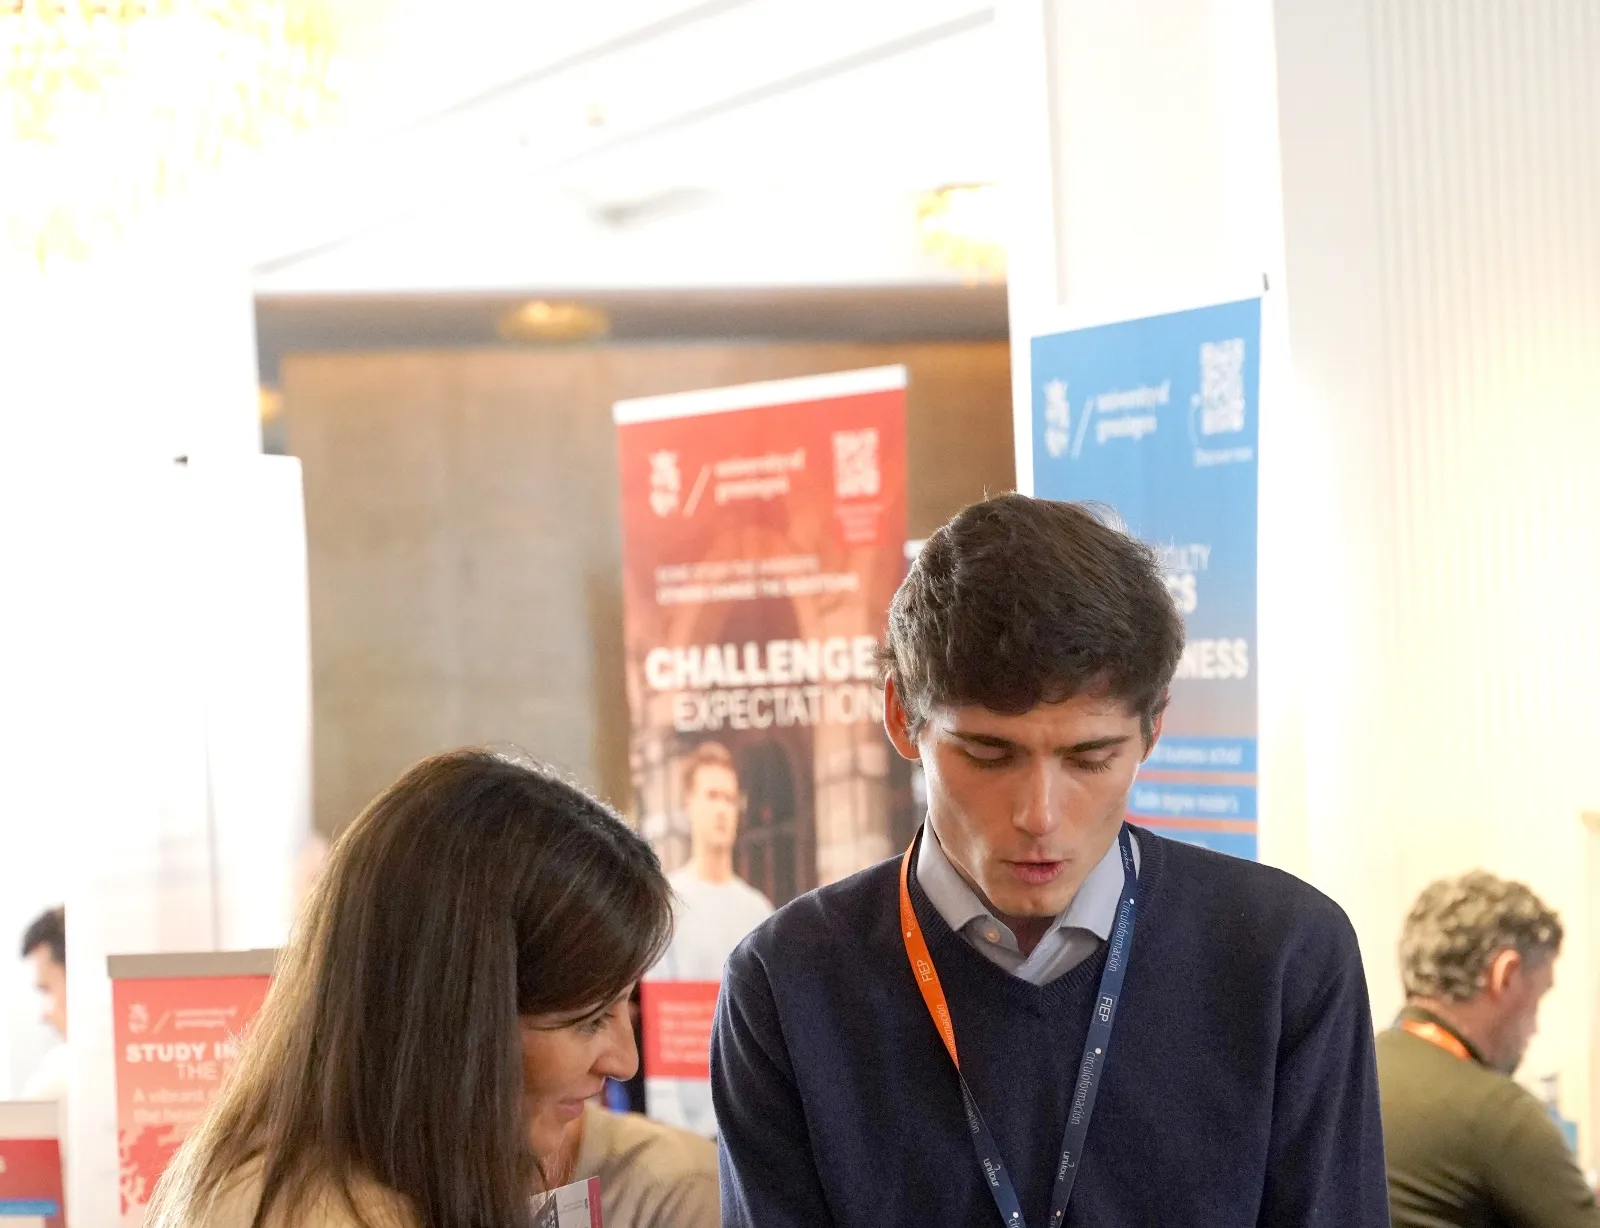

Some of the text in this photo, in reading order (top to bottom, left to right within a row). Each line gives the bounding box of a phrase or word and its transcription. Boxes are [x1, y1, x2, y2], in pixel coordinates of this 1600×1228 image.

[645, 635, 879, 691] CHALLENGE
[673, 684, 886, 733] EXPECTATION
[917, 959, 933, 982] FIEP
[1098, 996, 1113, 1022] FIEP
[125, 1041, 206, 1064] STUDY
[175, 1060, 218, 1081] THE
